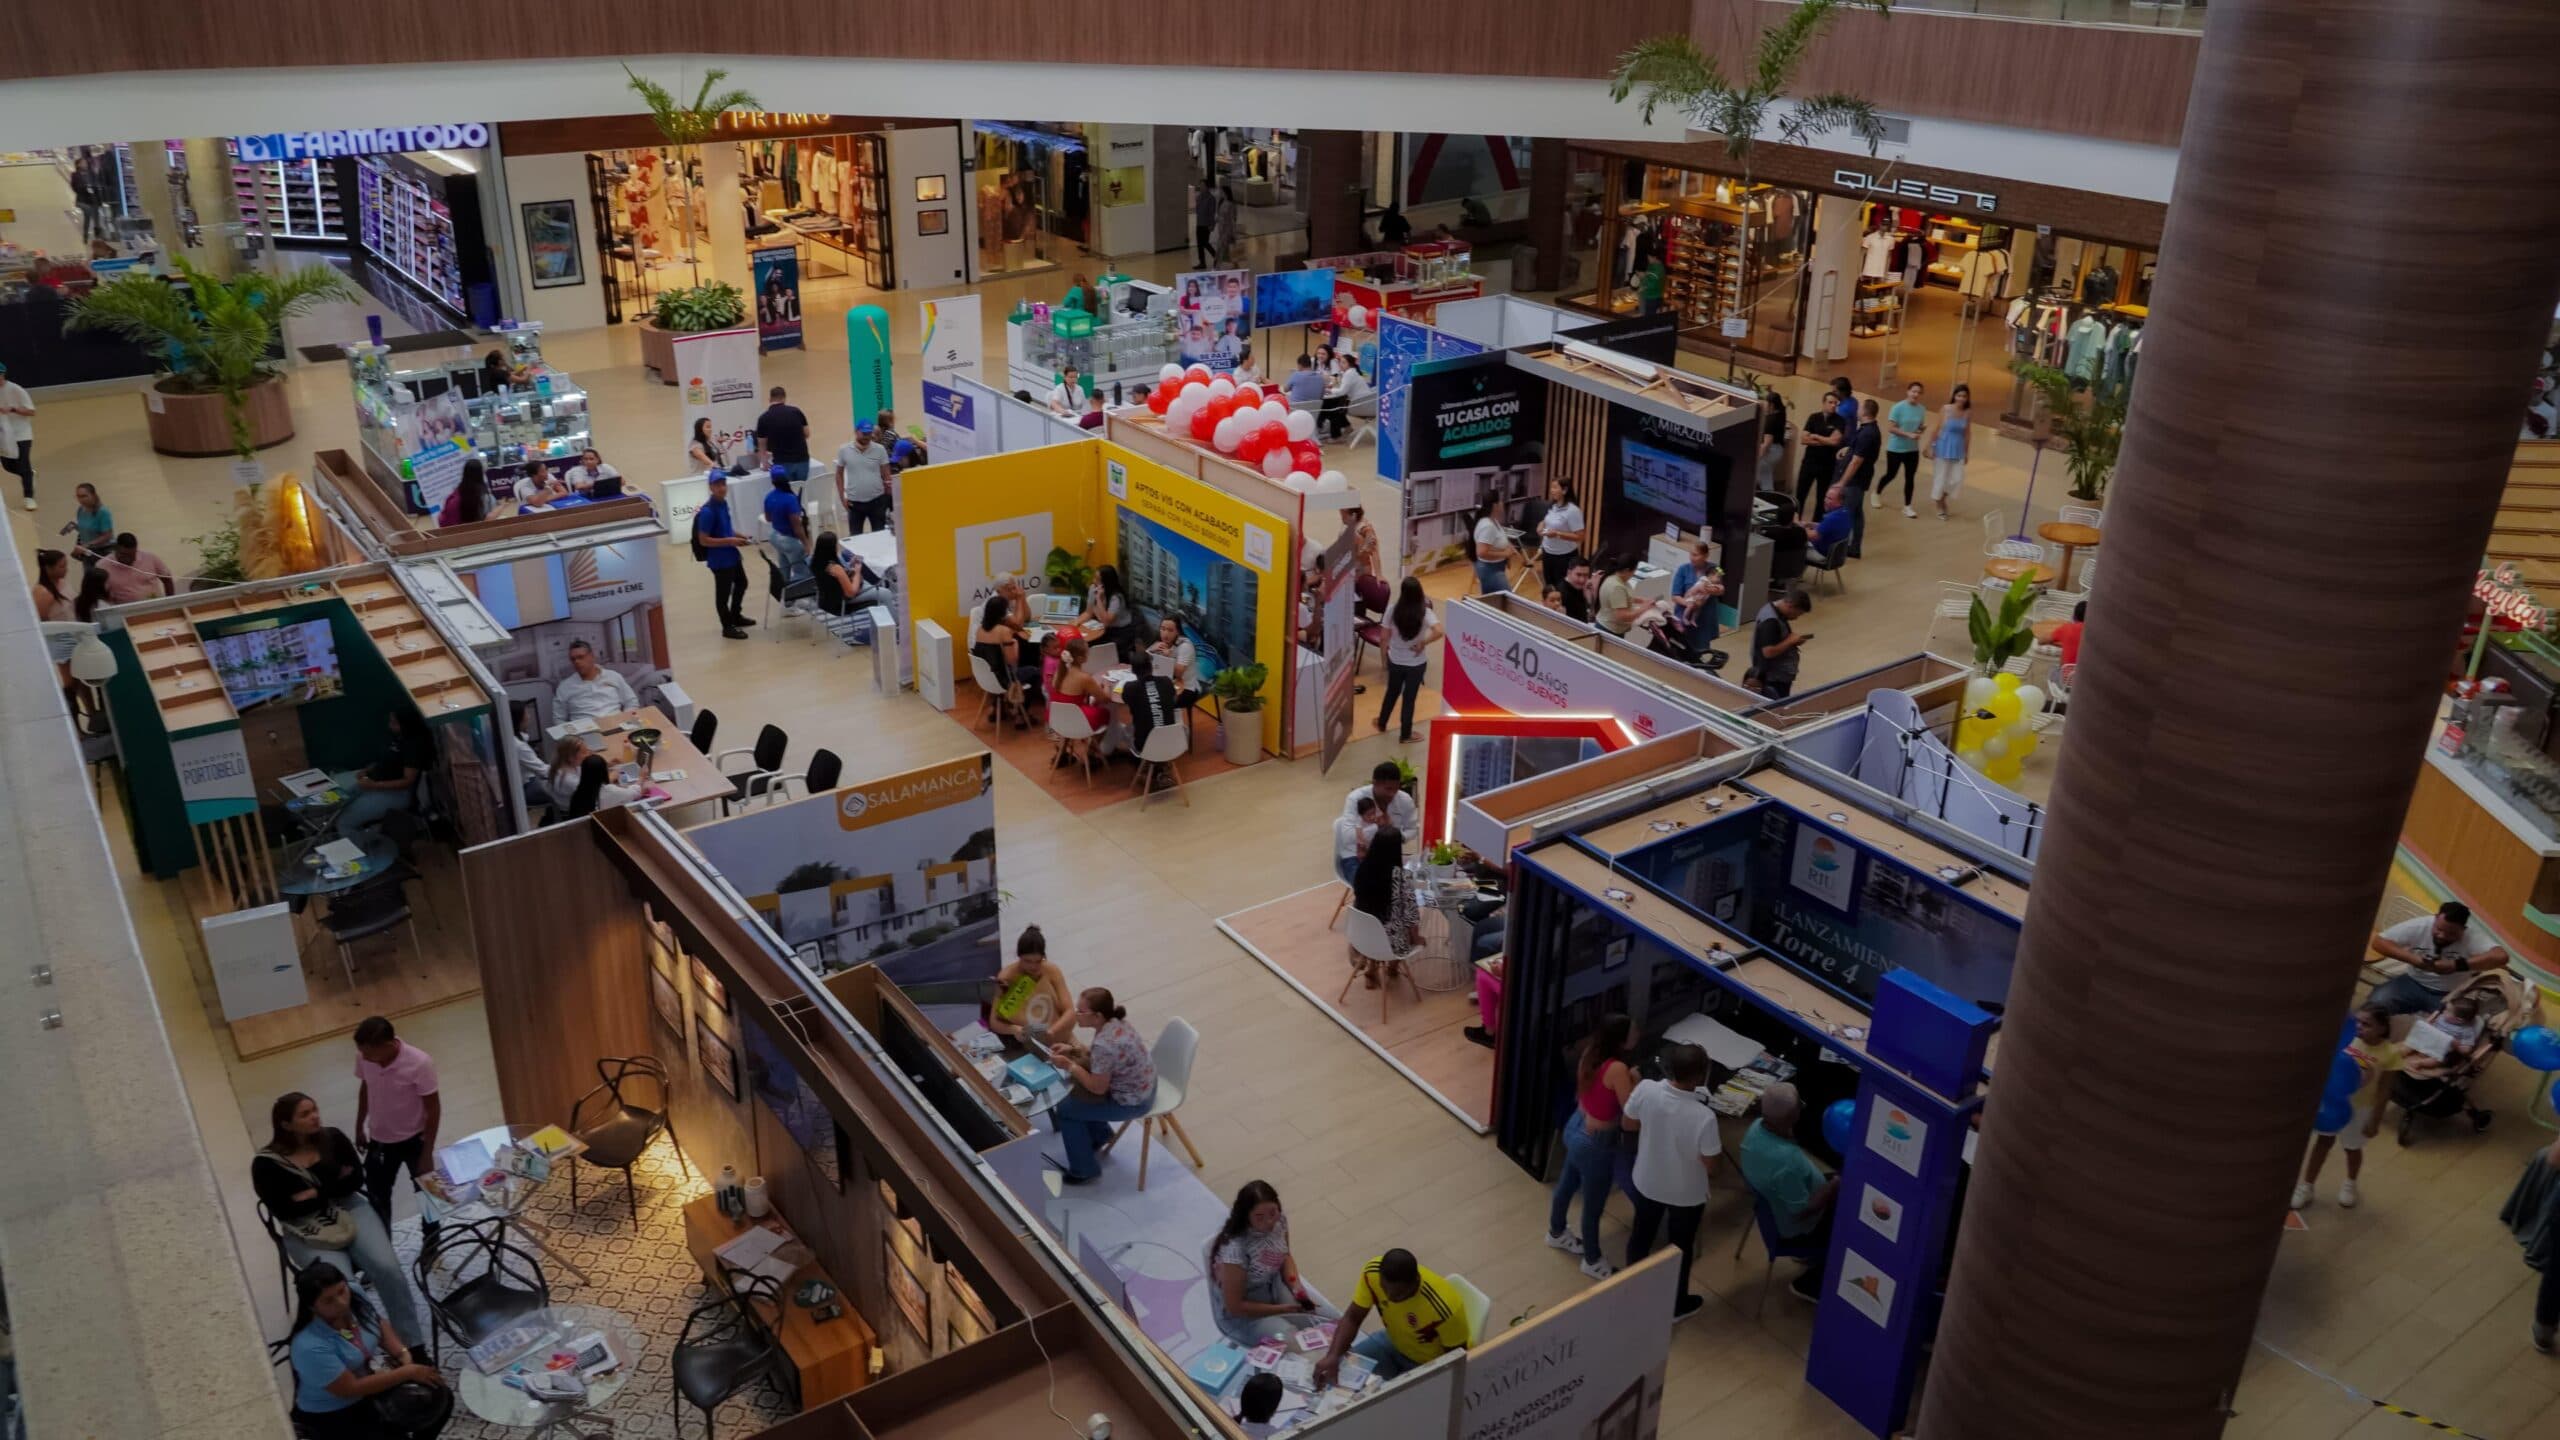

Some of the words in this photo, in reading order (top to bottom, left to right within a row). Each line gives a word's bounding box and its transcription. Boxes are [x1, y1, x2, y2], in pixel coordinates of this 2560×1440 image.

[284, 123, 489, 158] FARMATODO
[1834, 169, 1996, 210] QUEST
[871, 358, 884, 411] colombia
[1435, 412, 1455, 428] TU
[1456, 405, 1490, 424] CASA
[1491, 400, 1520, 416] CON
[1442, 417, 1512, 443] ACABADOS
[1658, 418, 1714, 447] MIRAZUR
[1135, 482, 1160, 500] APTOS
[1161, 493, 1174, 507] VIS
[1175, 500, 1192, 516] CON
[1194, 508, 1239, 538] ACABADOS
[569, 589, 615, 602] nstructora
[624, 582, 644, 593] EME
[1461, 631, 1486, 653] MÁS
[1487, 643, 1503, 657] DE
[1505, 641, 1539, 678] 40
[1537, 670, 1569, 695] AÑOS
[1526, 680, 1569, 709] SUEÑOS
[184, 758, 245, 785] PORTOBELO
[868, 768, 978, 809] SALAMANCA
[1772, 921, 1837, 972] Torre
[1842, 963, 1860, 984] 4
[1773, 900, 1897, 974] ¡LANZAMIEN
[1512, 1375, 1584, 1422] NOSOTROS
